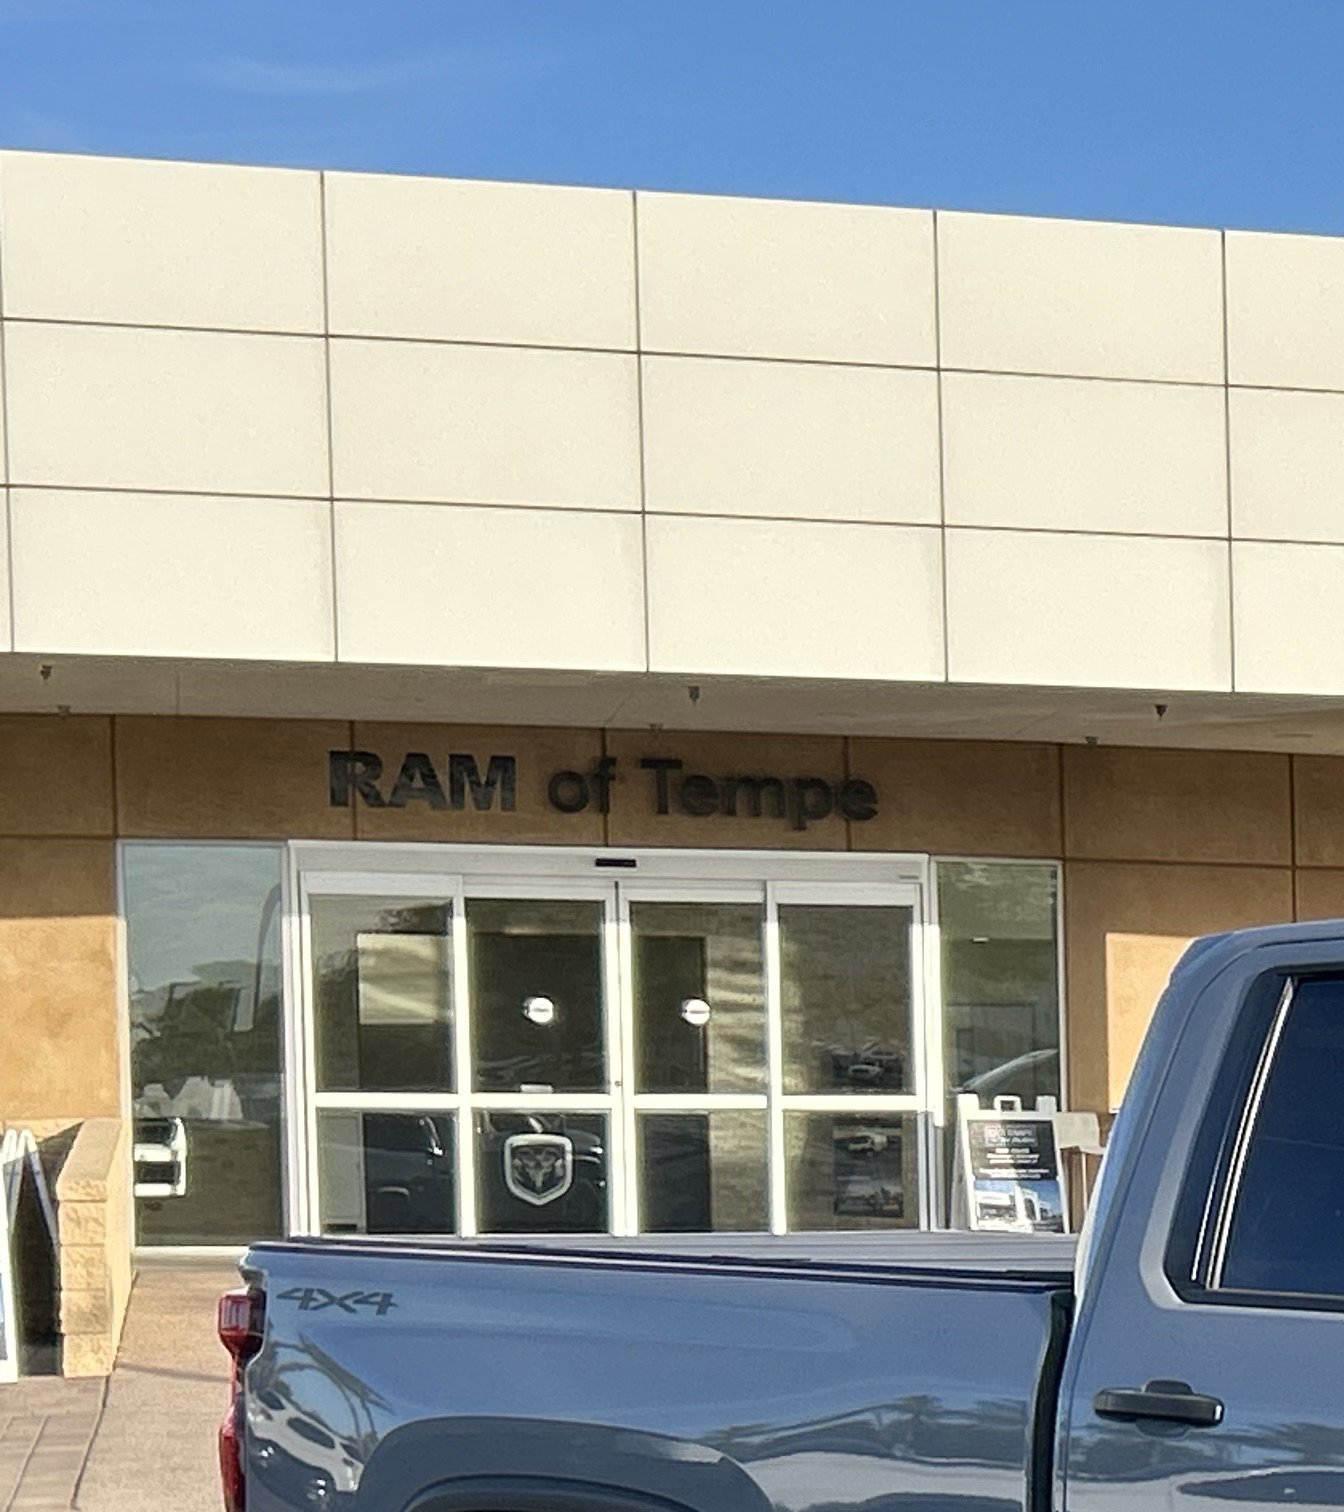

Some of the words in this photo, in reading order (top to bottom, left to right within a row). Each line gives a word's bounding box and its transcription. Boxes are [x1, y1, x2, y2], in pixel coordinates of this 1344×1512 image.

[329, 750, 516, 812] RAM
[548, 756, 617, 815] of
[640, 758, 878, 831] Tempe
[276, 1287, 399, 1316] 4X4
